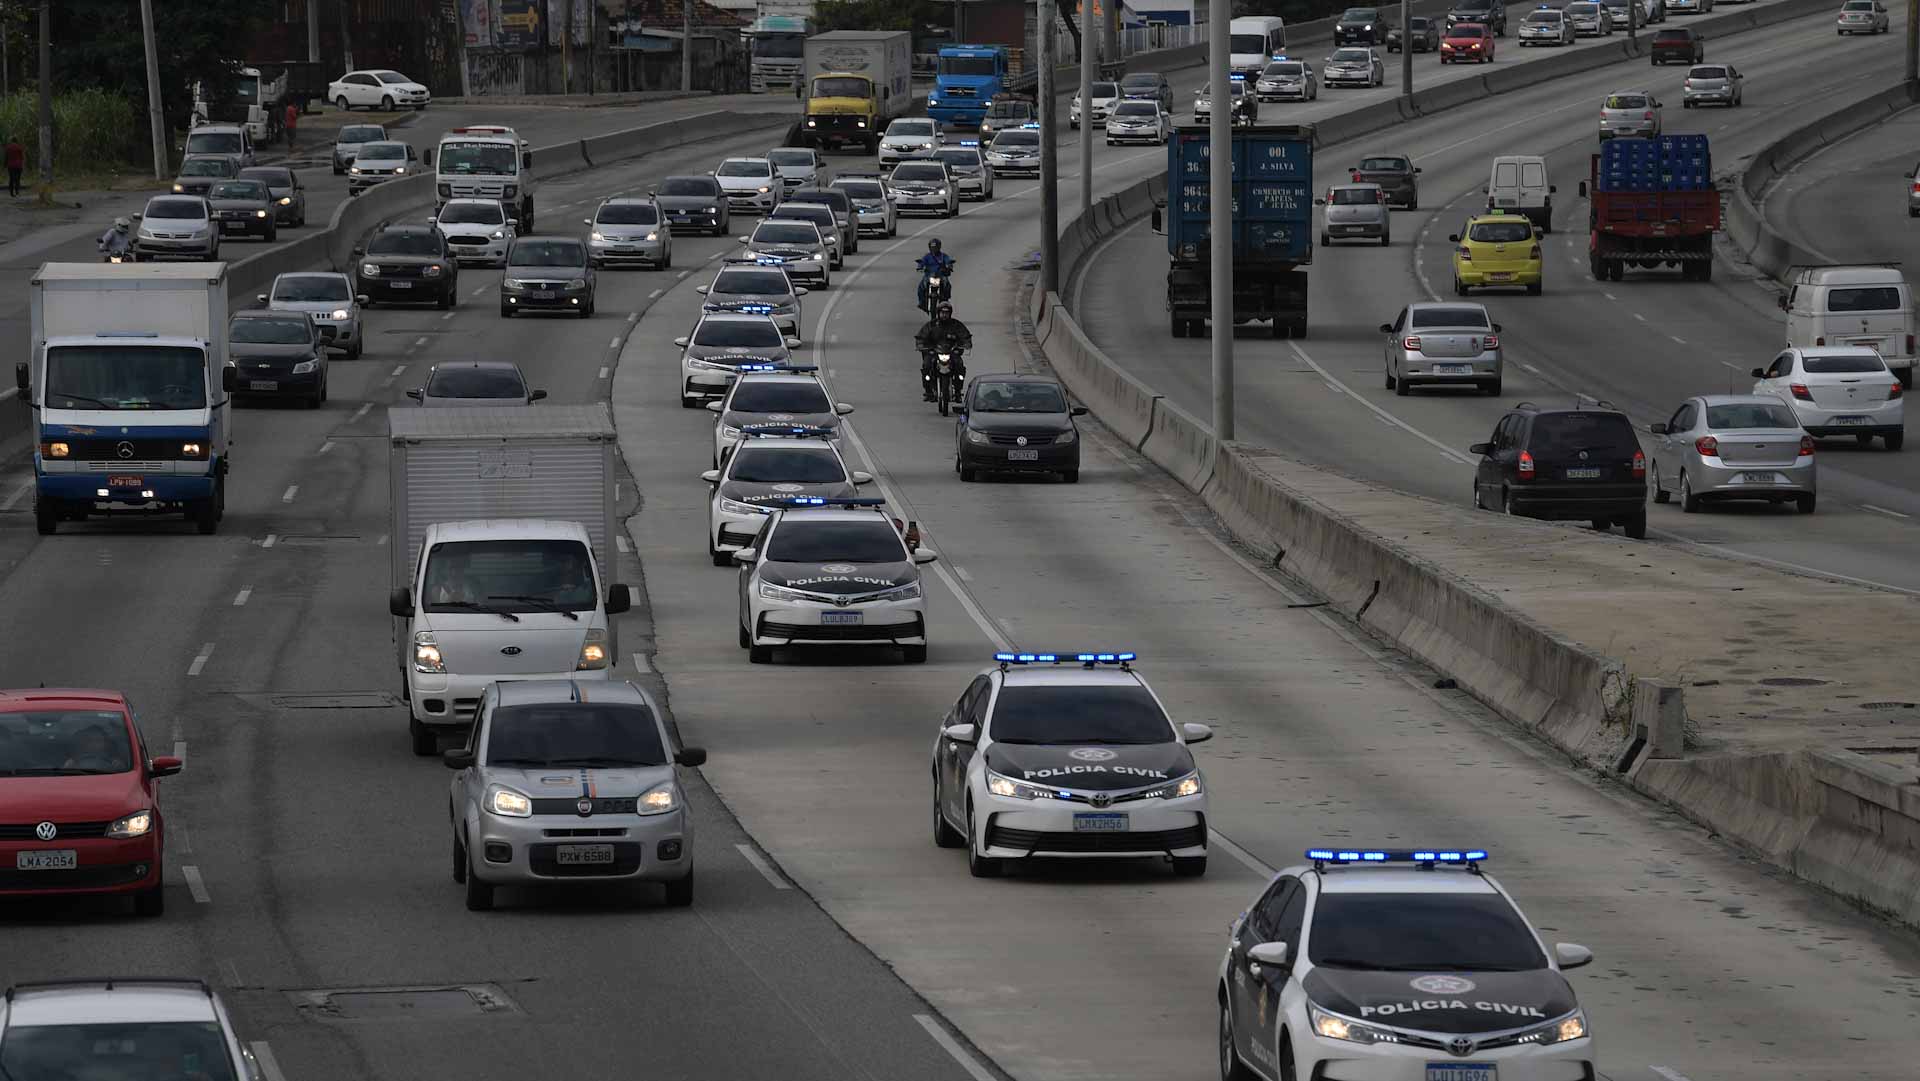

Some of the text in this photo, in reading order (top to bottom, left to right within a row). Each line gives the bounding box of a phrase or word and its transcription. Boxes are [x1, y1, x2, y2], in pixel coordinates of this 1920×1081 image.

[1268, 146, 1287, 158] 001
[1270, 162, 1295, 171] SILVA
[853, 576, 896, 587] CIVIL
[1112, 766, 1168, 779] CIVIL
[1474, 1001, 1546, 1018] CIVIL
